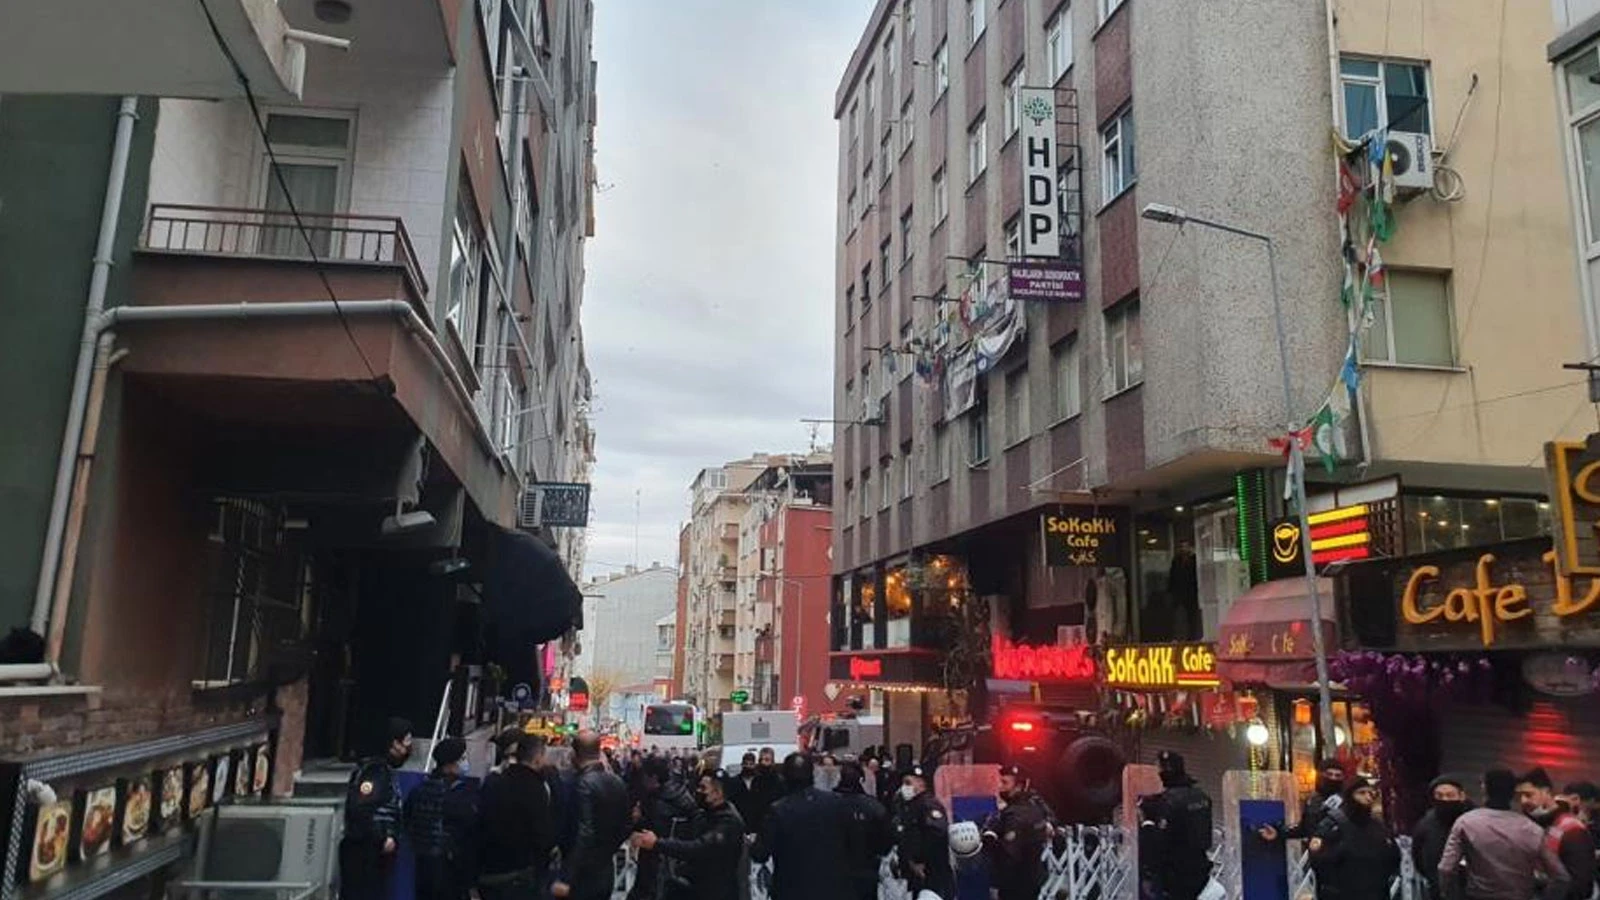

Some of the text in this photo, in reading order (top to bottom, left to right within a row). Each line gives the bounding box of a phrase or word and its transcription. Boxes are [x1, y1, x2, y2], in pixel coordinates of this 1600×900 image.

[1028, 136, 1052, 245] HDP
[1067, 534, 1099, 547] Cafe
[1402, 553, 1533, 648] Cafe
[1182, 645, 1213, 672] Cafe
